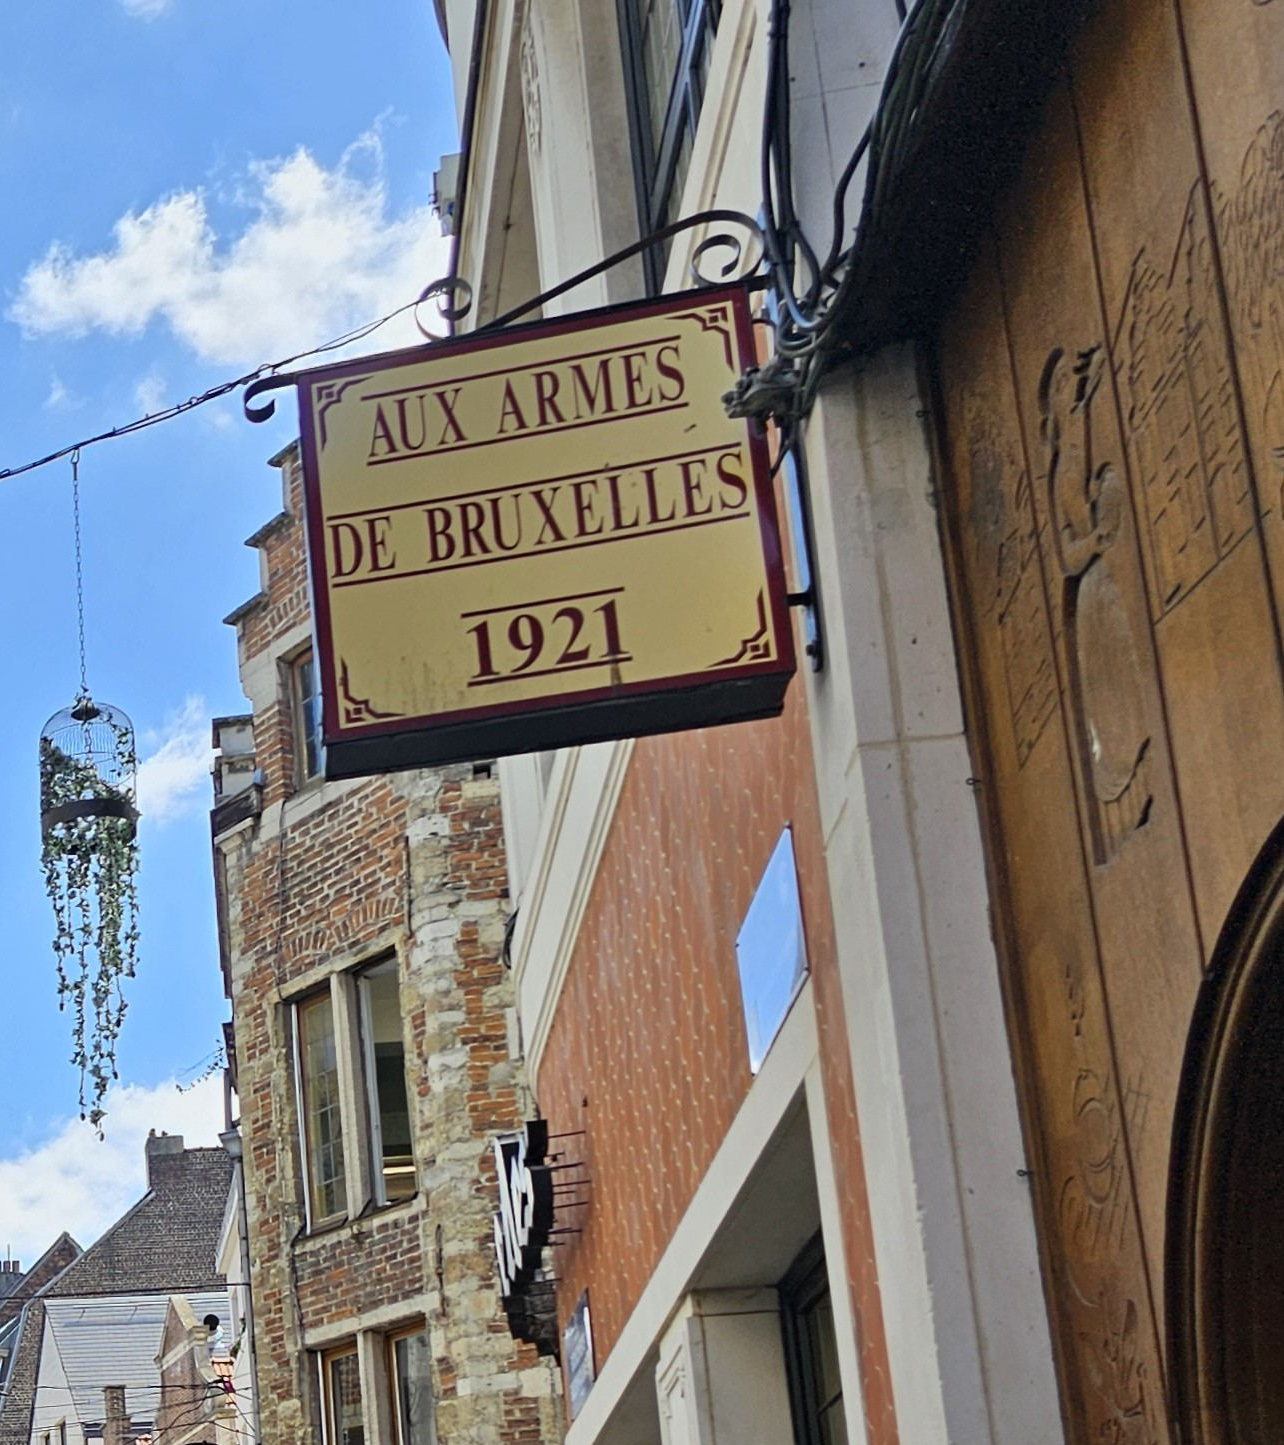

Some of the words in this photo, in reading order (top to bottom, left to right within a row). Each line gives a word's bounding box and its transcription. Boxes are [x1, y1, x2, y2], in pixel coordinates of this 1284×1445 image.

[367, 386, 467, 458] AUX
[496, 344, 687, 435] ARMES
[329, 515, 397, 579] DE
[425, 451, 749, 564] BRUXELLES
[466, 598, 631, 680] 1921
